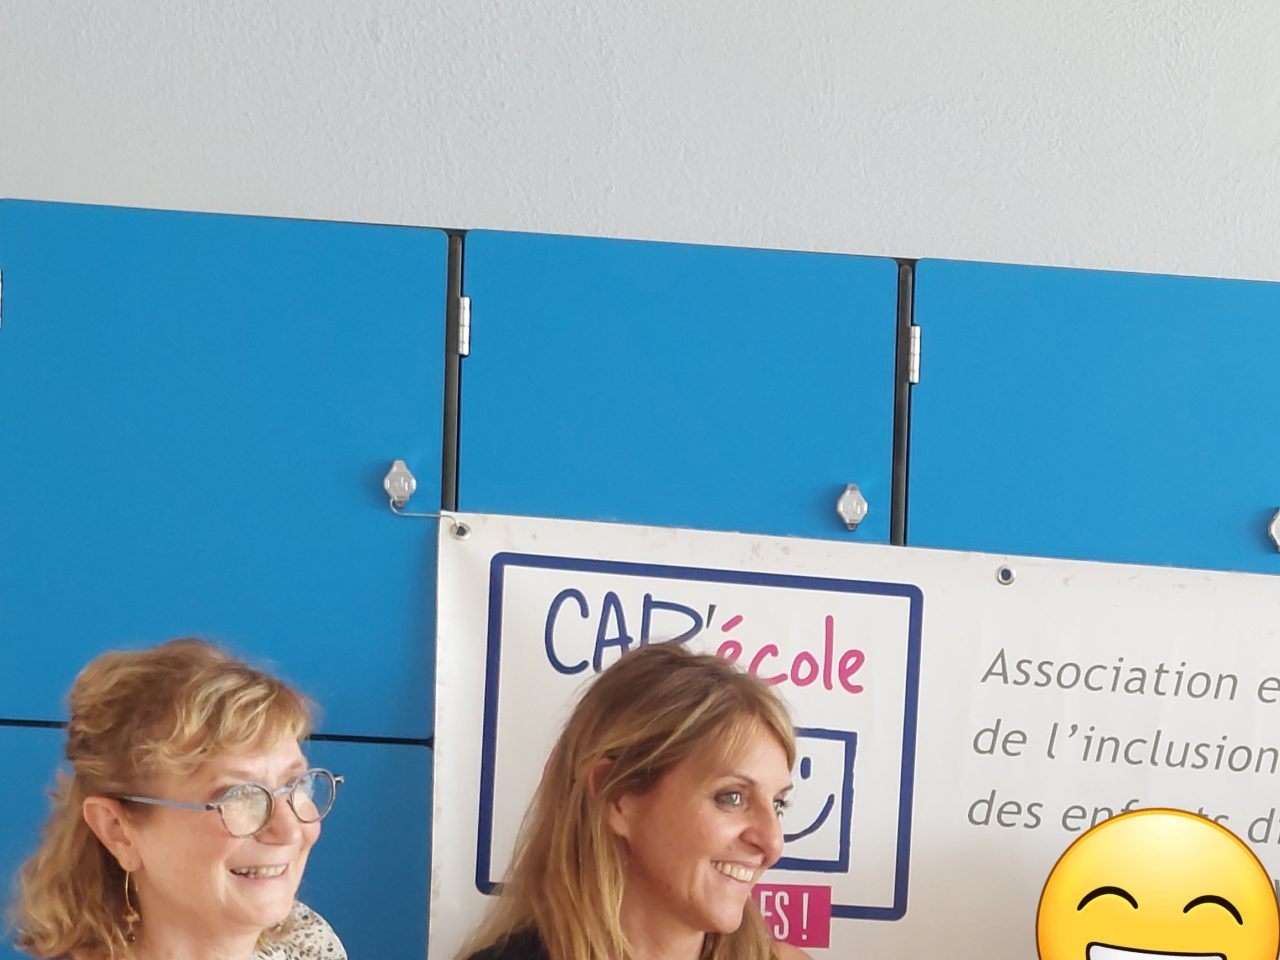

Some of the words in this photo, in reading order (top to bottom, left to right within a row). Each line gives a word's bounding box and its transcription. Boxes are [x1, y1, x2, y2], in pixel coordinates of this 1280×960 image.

[980, 647, 1238, 701] Association
[972, 718, 1028, 757] de
[967, 789, 1044, 830] des
